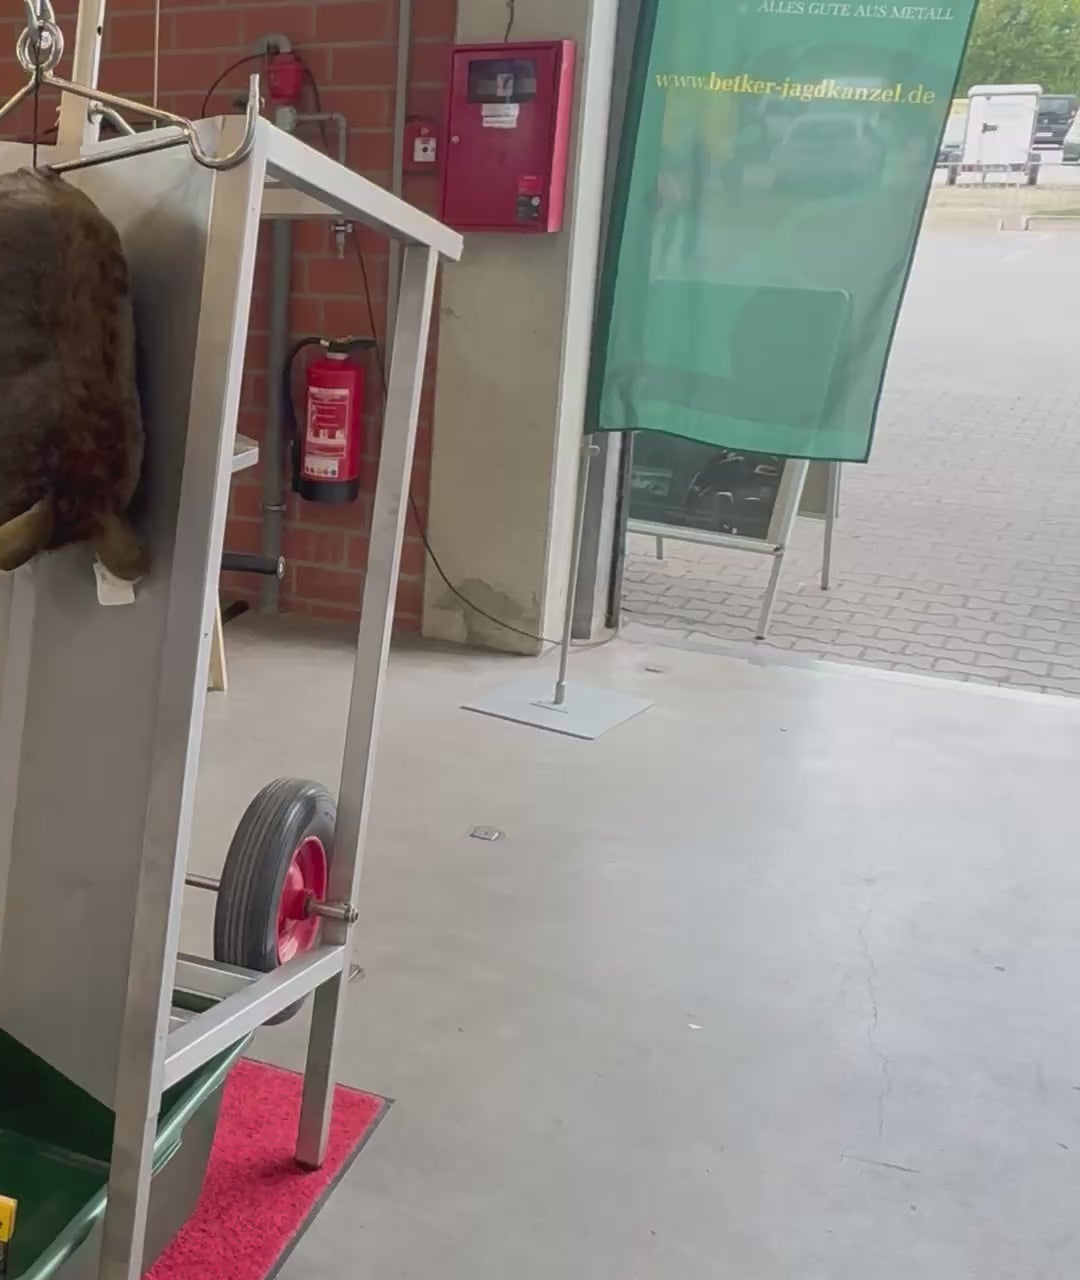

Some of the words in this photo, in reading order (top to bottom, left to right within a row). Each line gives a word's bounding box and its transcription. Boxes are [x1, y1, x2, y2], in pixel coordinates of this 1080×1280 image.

[758, 0, 805, 14] ALLES
[809, 2, 850, 17] GUTE
[854, 4, 887, 18] AUS
[890, 6, 954, 20] METALL
[655, 72, 936, 104] www.betker-jagdkanzel.de
